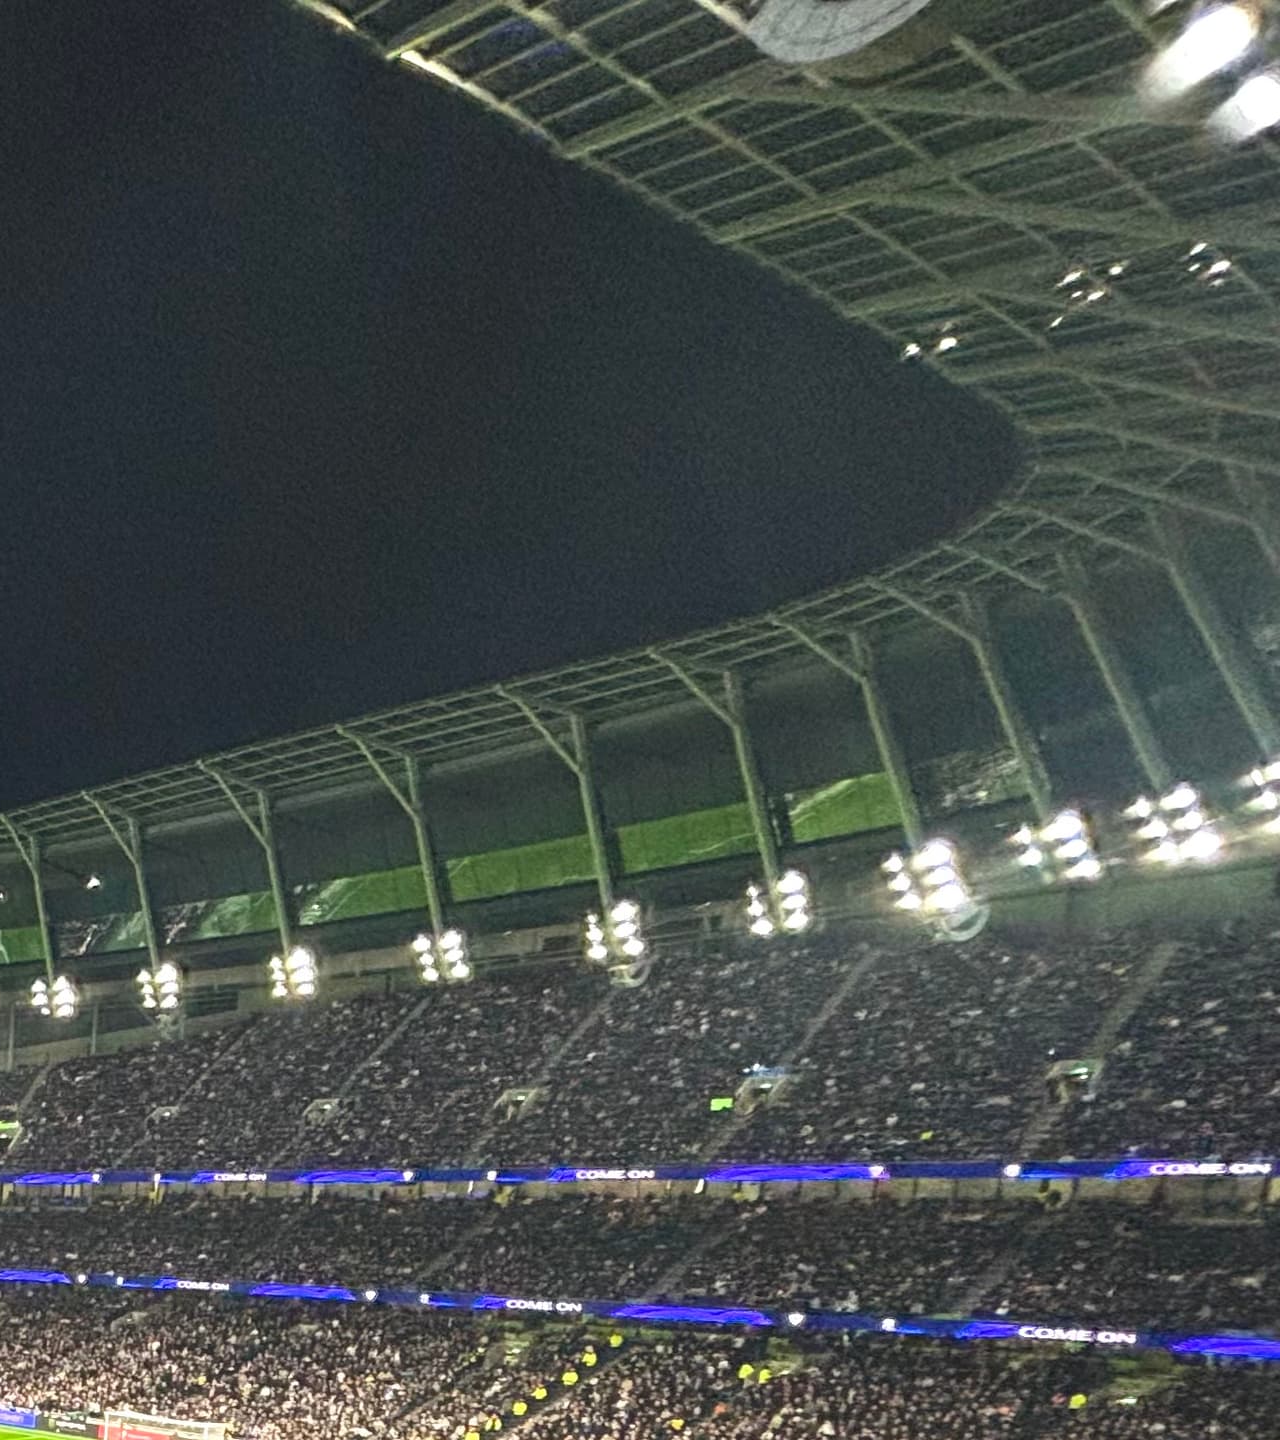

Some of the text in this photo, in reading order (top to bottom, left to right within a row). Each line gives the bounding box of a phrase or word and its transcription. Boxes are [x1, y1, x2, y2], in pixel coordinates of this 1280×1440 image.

[1228, 1163, 1272, 1174] ON
[555, 1301, 582, 1312] ON
[1018, 1325, 1137, 1344] COME ON
